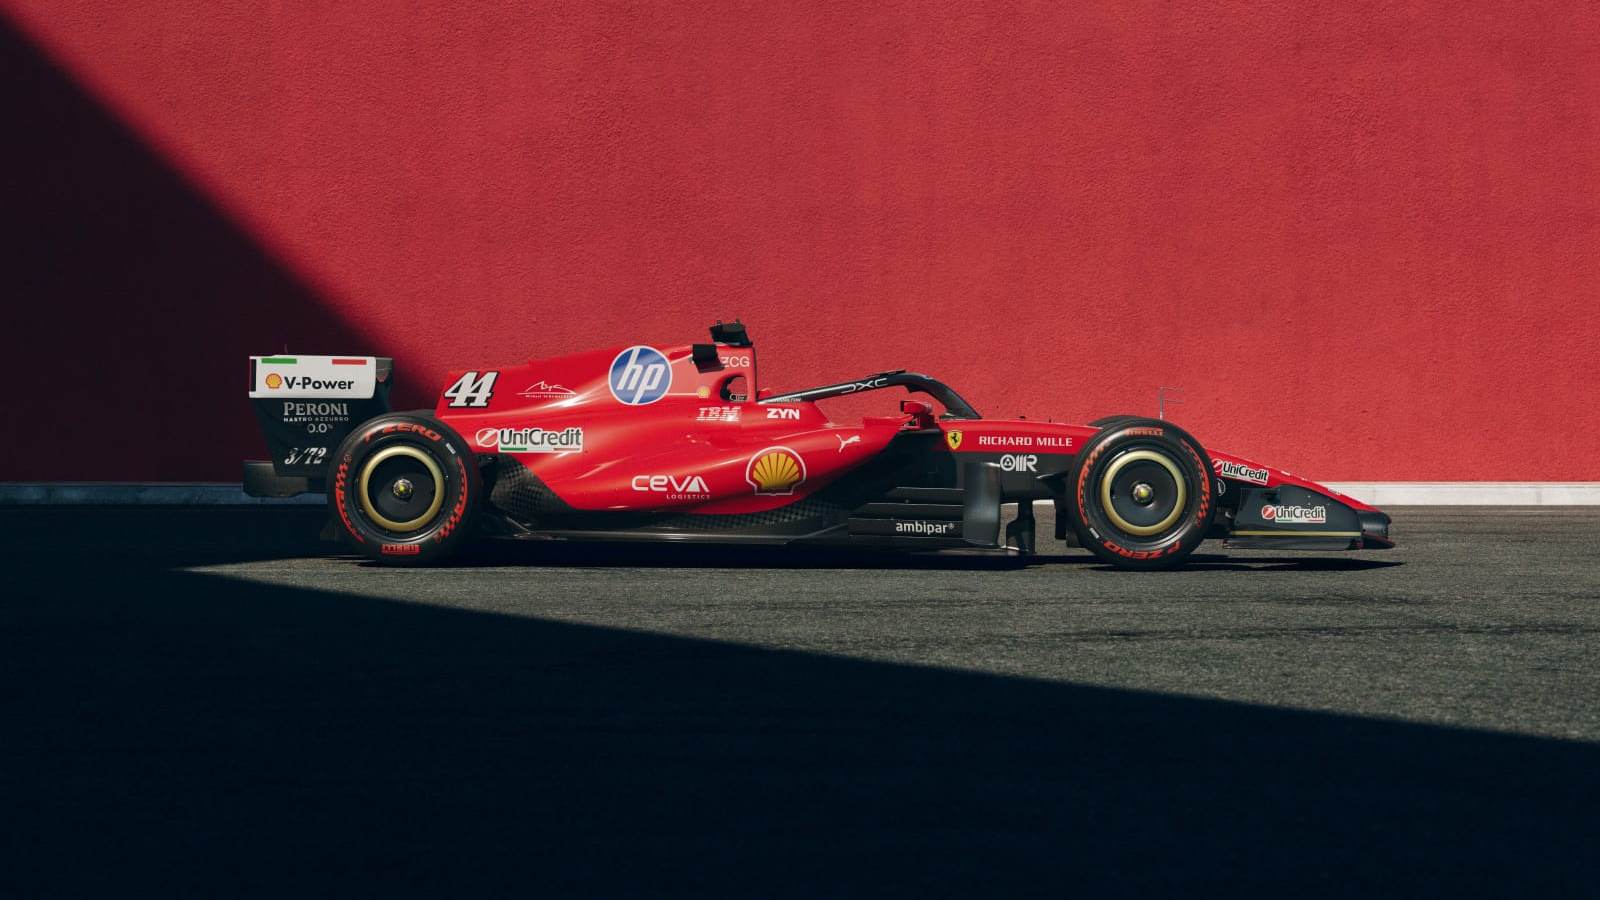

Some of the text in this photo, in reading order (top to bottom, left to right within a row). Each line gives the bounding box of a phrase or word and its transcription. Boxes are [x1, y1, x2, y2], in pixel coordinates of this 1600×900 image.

[284, 377, 354, 390] V-Power
[617, 349, 666, 404] hp
[444, 371, 499, 408] 44
[283, 402, 349, 416] PERONI
[696, 406, 741, 421] IBM
[767, 408, 800, 419] ZYN
[500, 429, 582, 447] UniCredit
[979, 436, 1073, 447] RICHARD MILLE
[1222, 462, 1268, 480] UniCredit
[1276, 506, 1325, 519] UniCredit
